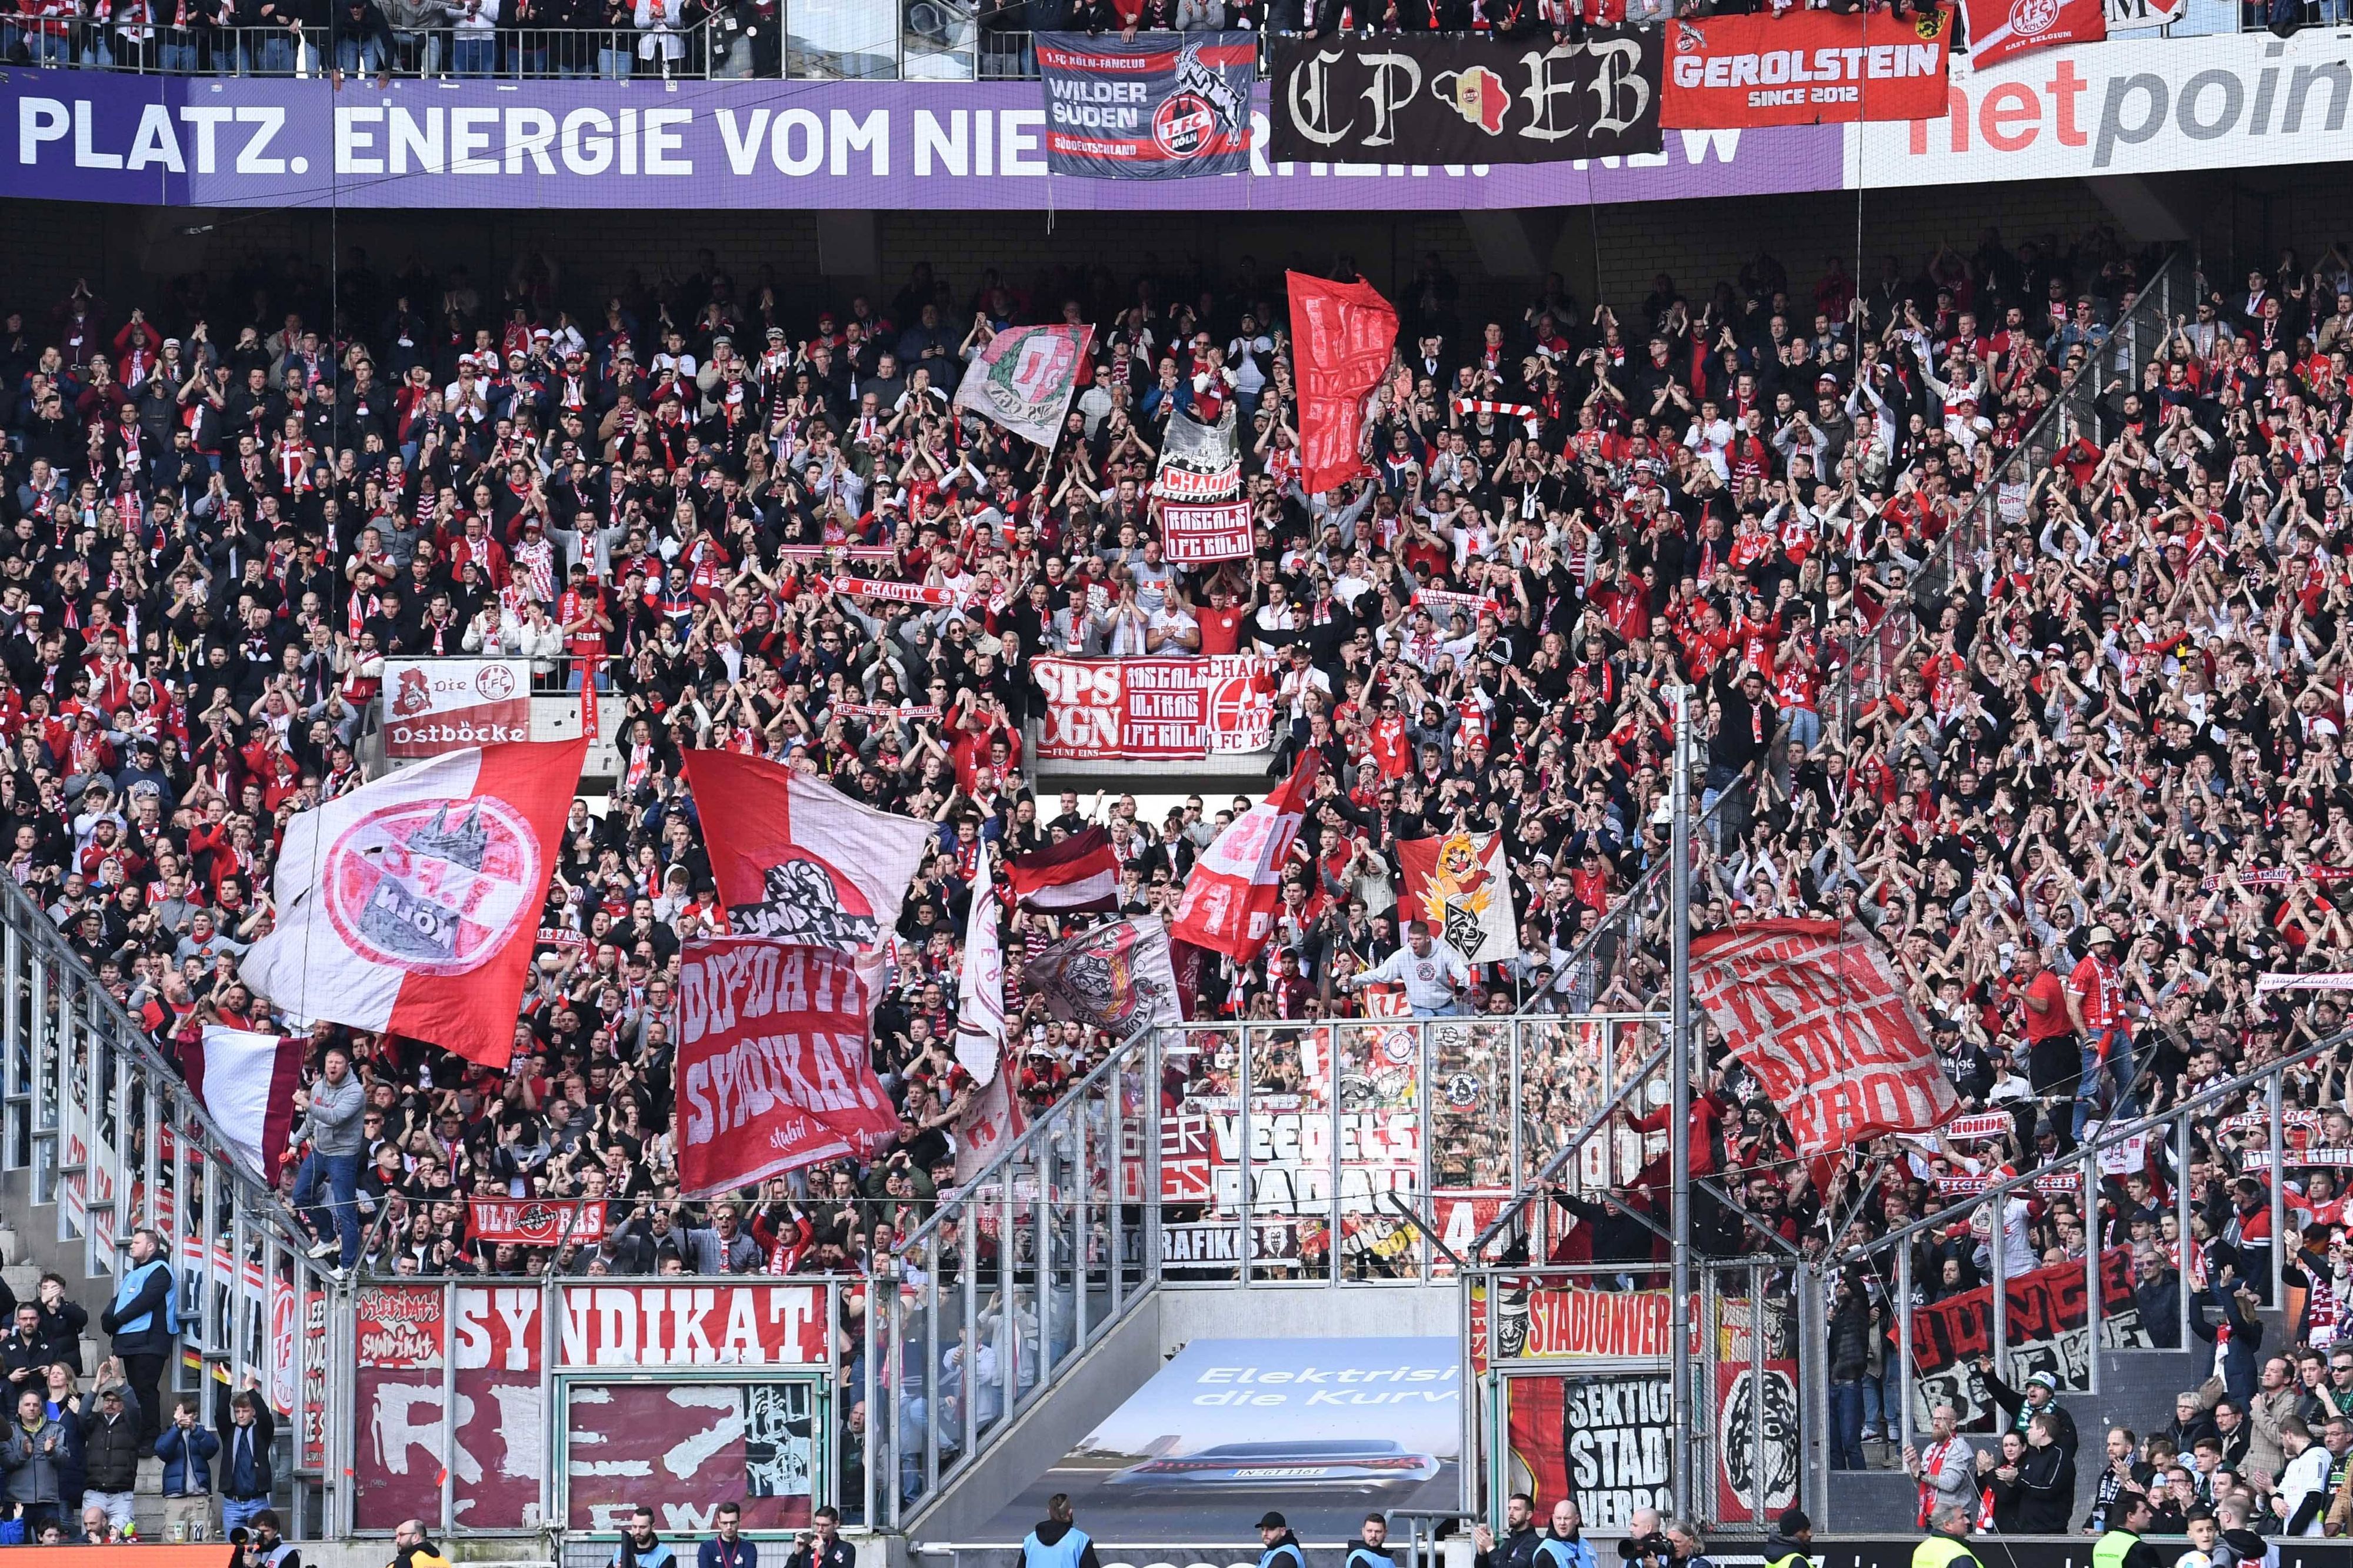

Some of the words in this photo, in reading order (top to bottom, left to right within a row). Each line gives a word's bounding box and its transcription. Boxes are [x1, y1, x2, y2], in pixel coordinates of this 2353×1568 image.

[2005, 40, 2027, 52] EAST
[2029, 31, 2072, 44] BELGIUM
[1047, 52, 1066, 65] 1.FC
[1069, 54, 1145, 69] KÖLN-FANCLUB
[1674, 43, 1939, 88] GEROLSTEIN
[1049, 78, 1146, 102] WILDER
[1748, 87, 1805, 108] SINCE
[1811, 86, 1858, 104] 2012
[1052, 101, 1137, 128] SÜDEN
[1166, 112, 1202, 135] 1.FC
[19, 97, 308, 174] PLATZ.
[335, 106, 693, 176] ENERGIE
[715, 108, 889, 177] VOM
[1054, 138, 1136, 156] SÜDDEUTSCHLAND
[1171, 132, 1197, 148] KÖLN
[862, 582, 925, 601] CHAOTIX
[434, 678, 466, 692] Die
[1034, 662, 1121, 705] SPS
[1130, 695, 1199, 717] ULTRAS
[393, 720, 525, 743] Ostböcke
[1078, 749, 1099, 757] EINS
[1212, 1114, 1418, 1160] VEEDELS
[455, 1287, 812, 1370] SYNDIKAT
[1197, 1366, 1459, 1383] Elektrisi
[1192, 1390, 1287, 1406] die
